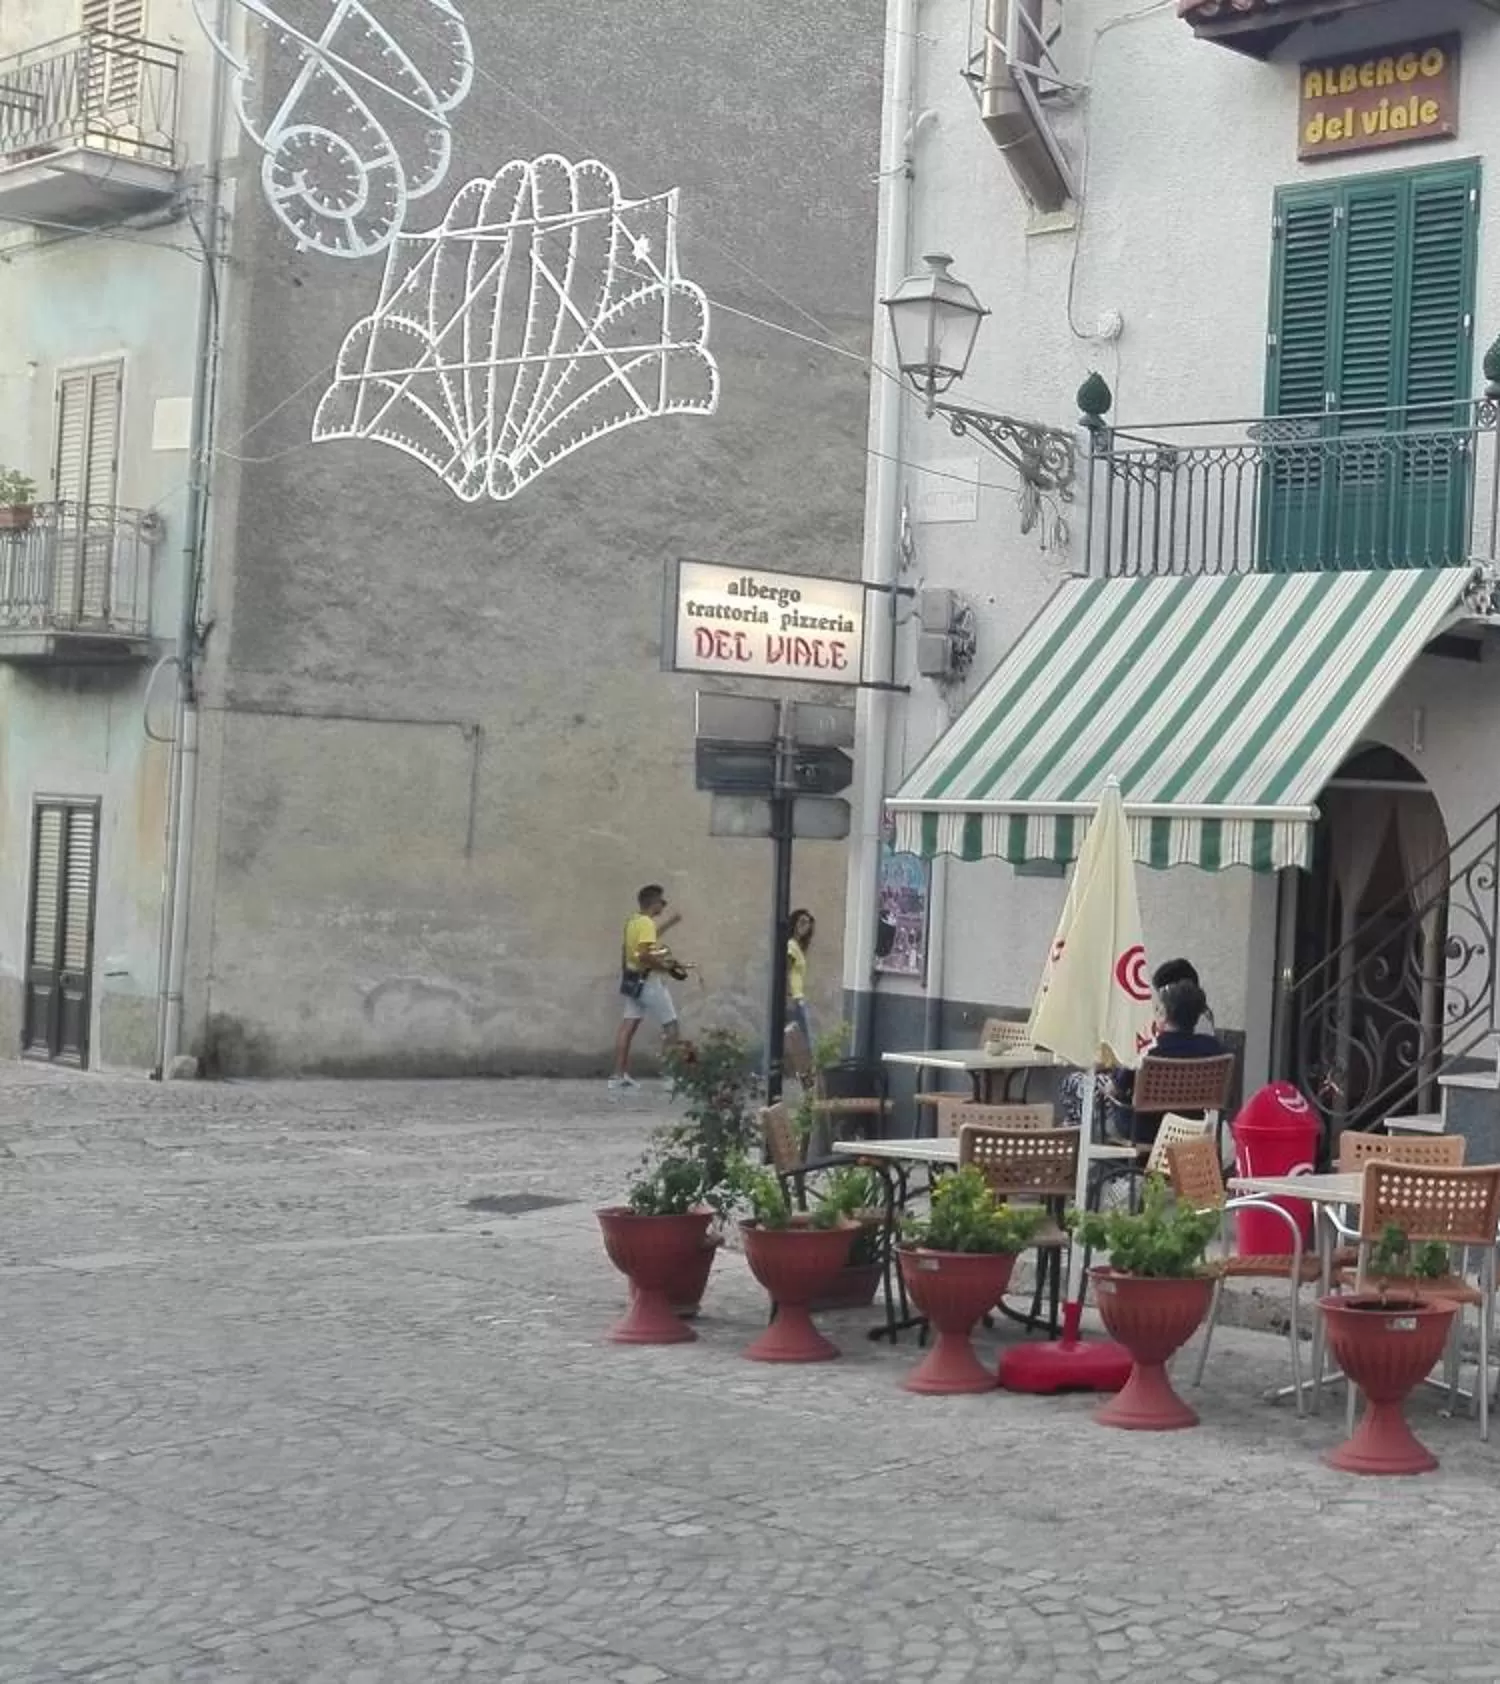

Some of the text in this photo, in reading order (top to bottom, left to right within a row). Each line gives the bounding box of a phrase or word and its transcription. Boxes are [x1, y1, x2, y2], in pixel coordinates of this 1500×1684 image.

[1304, 47, 1443, 99] ALBERGO
[1305, 96, 1438, 143] del viale
[728, 577, 801, 607] albergo
[686, 600, 854, 632] trattoria pizzeria
[694, 627, 848, 670] DEL VIALE
